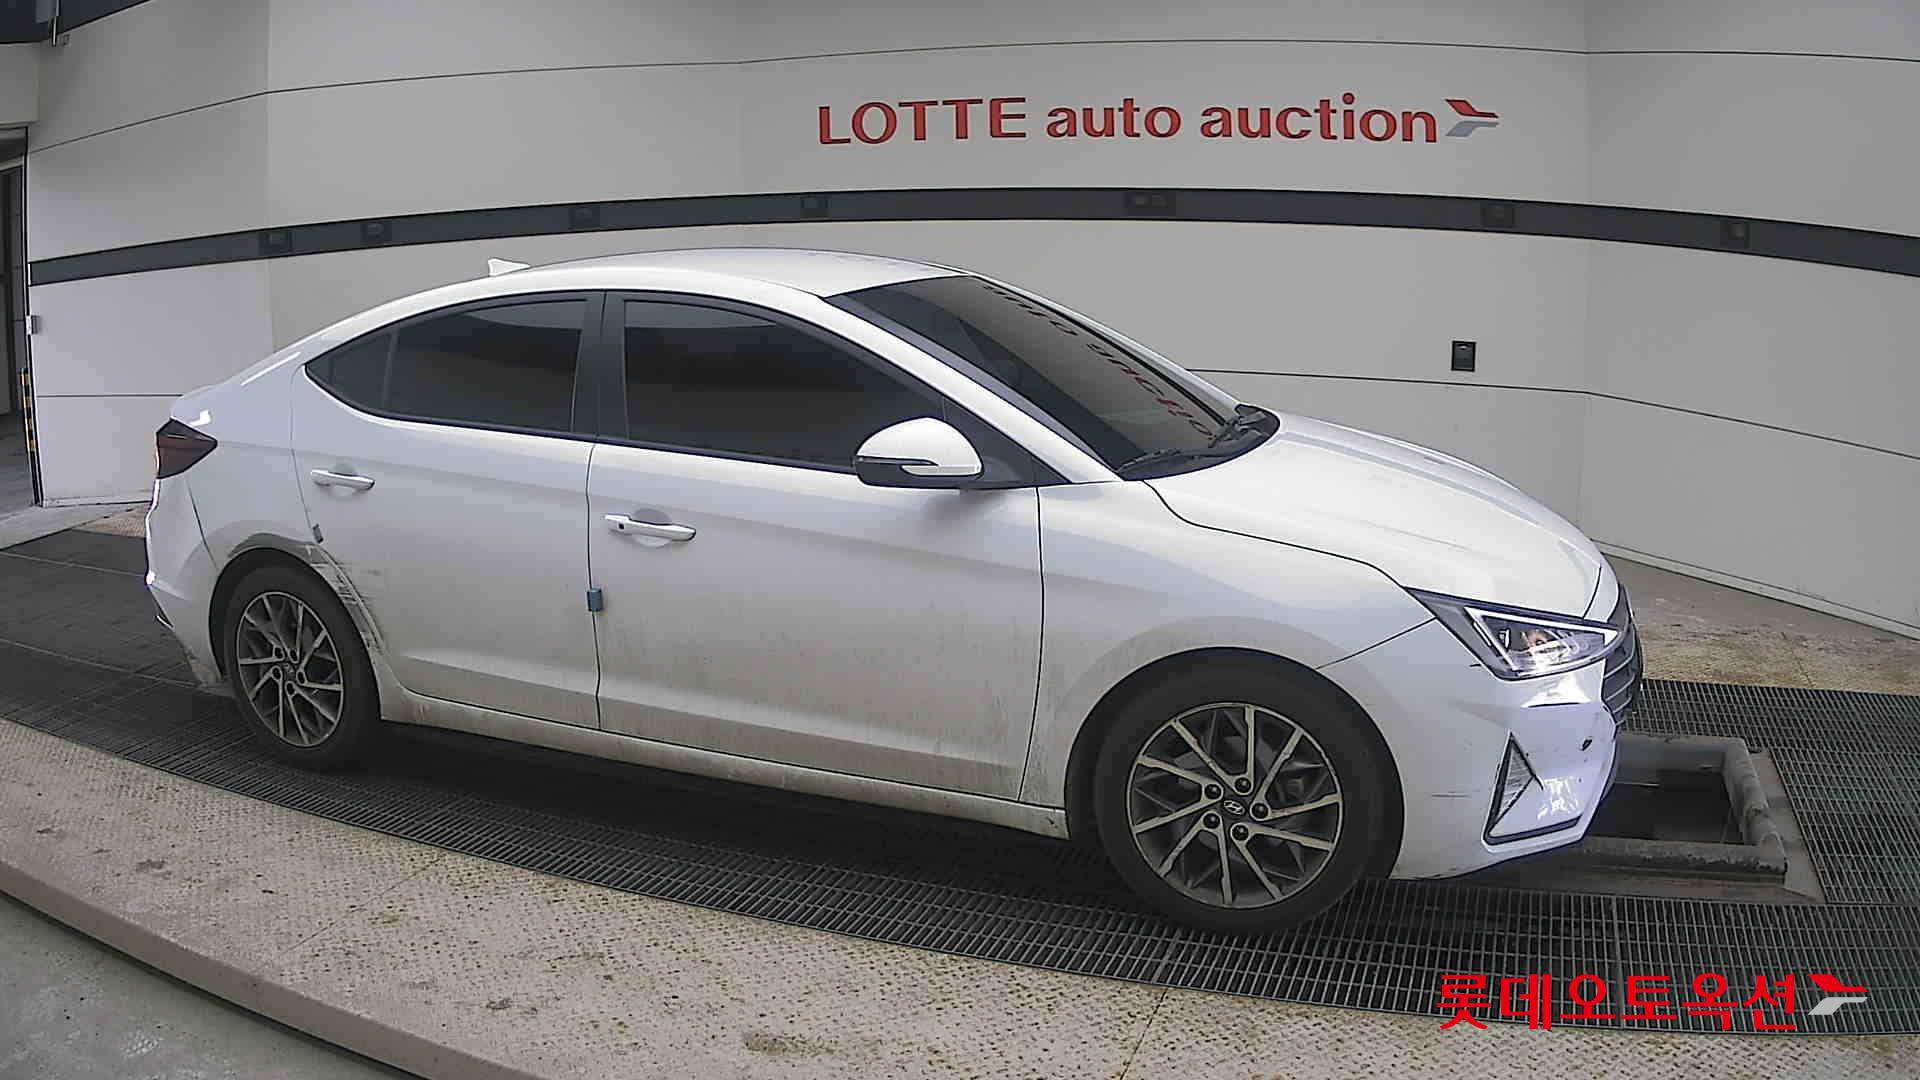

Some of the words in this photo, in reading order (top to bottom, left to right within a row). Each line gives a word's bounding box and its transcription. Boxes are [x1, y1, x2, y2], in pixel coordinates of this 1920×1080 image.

[818, 96, 1026, 146] LOTTE
[1045, 98, 1183, 140] auto
[1199, 92, 1440, 144] auction
